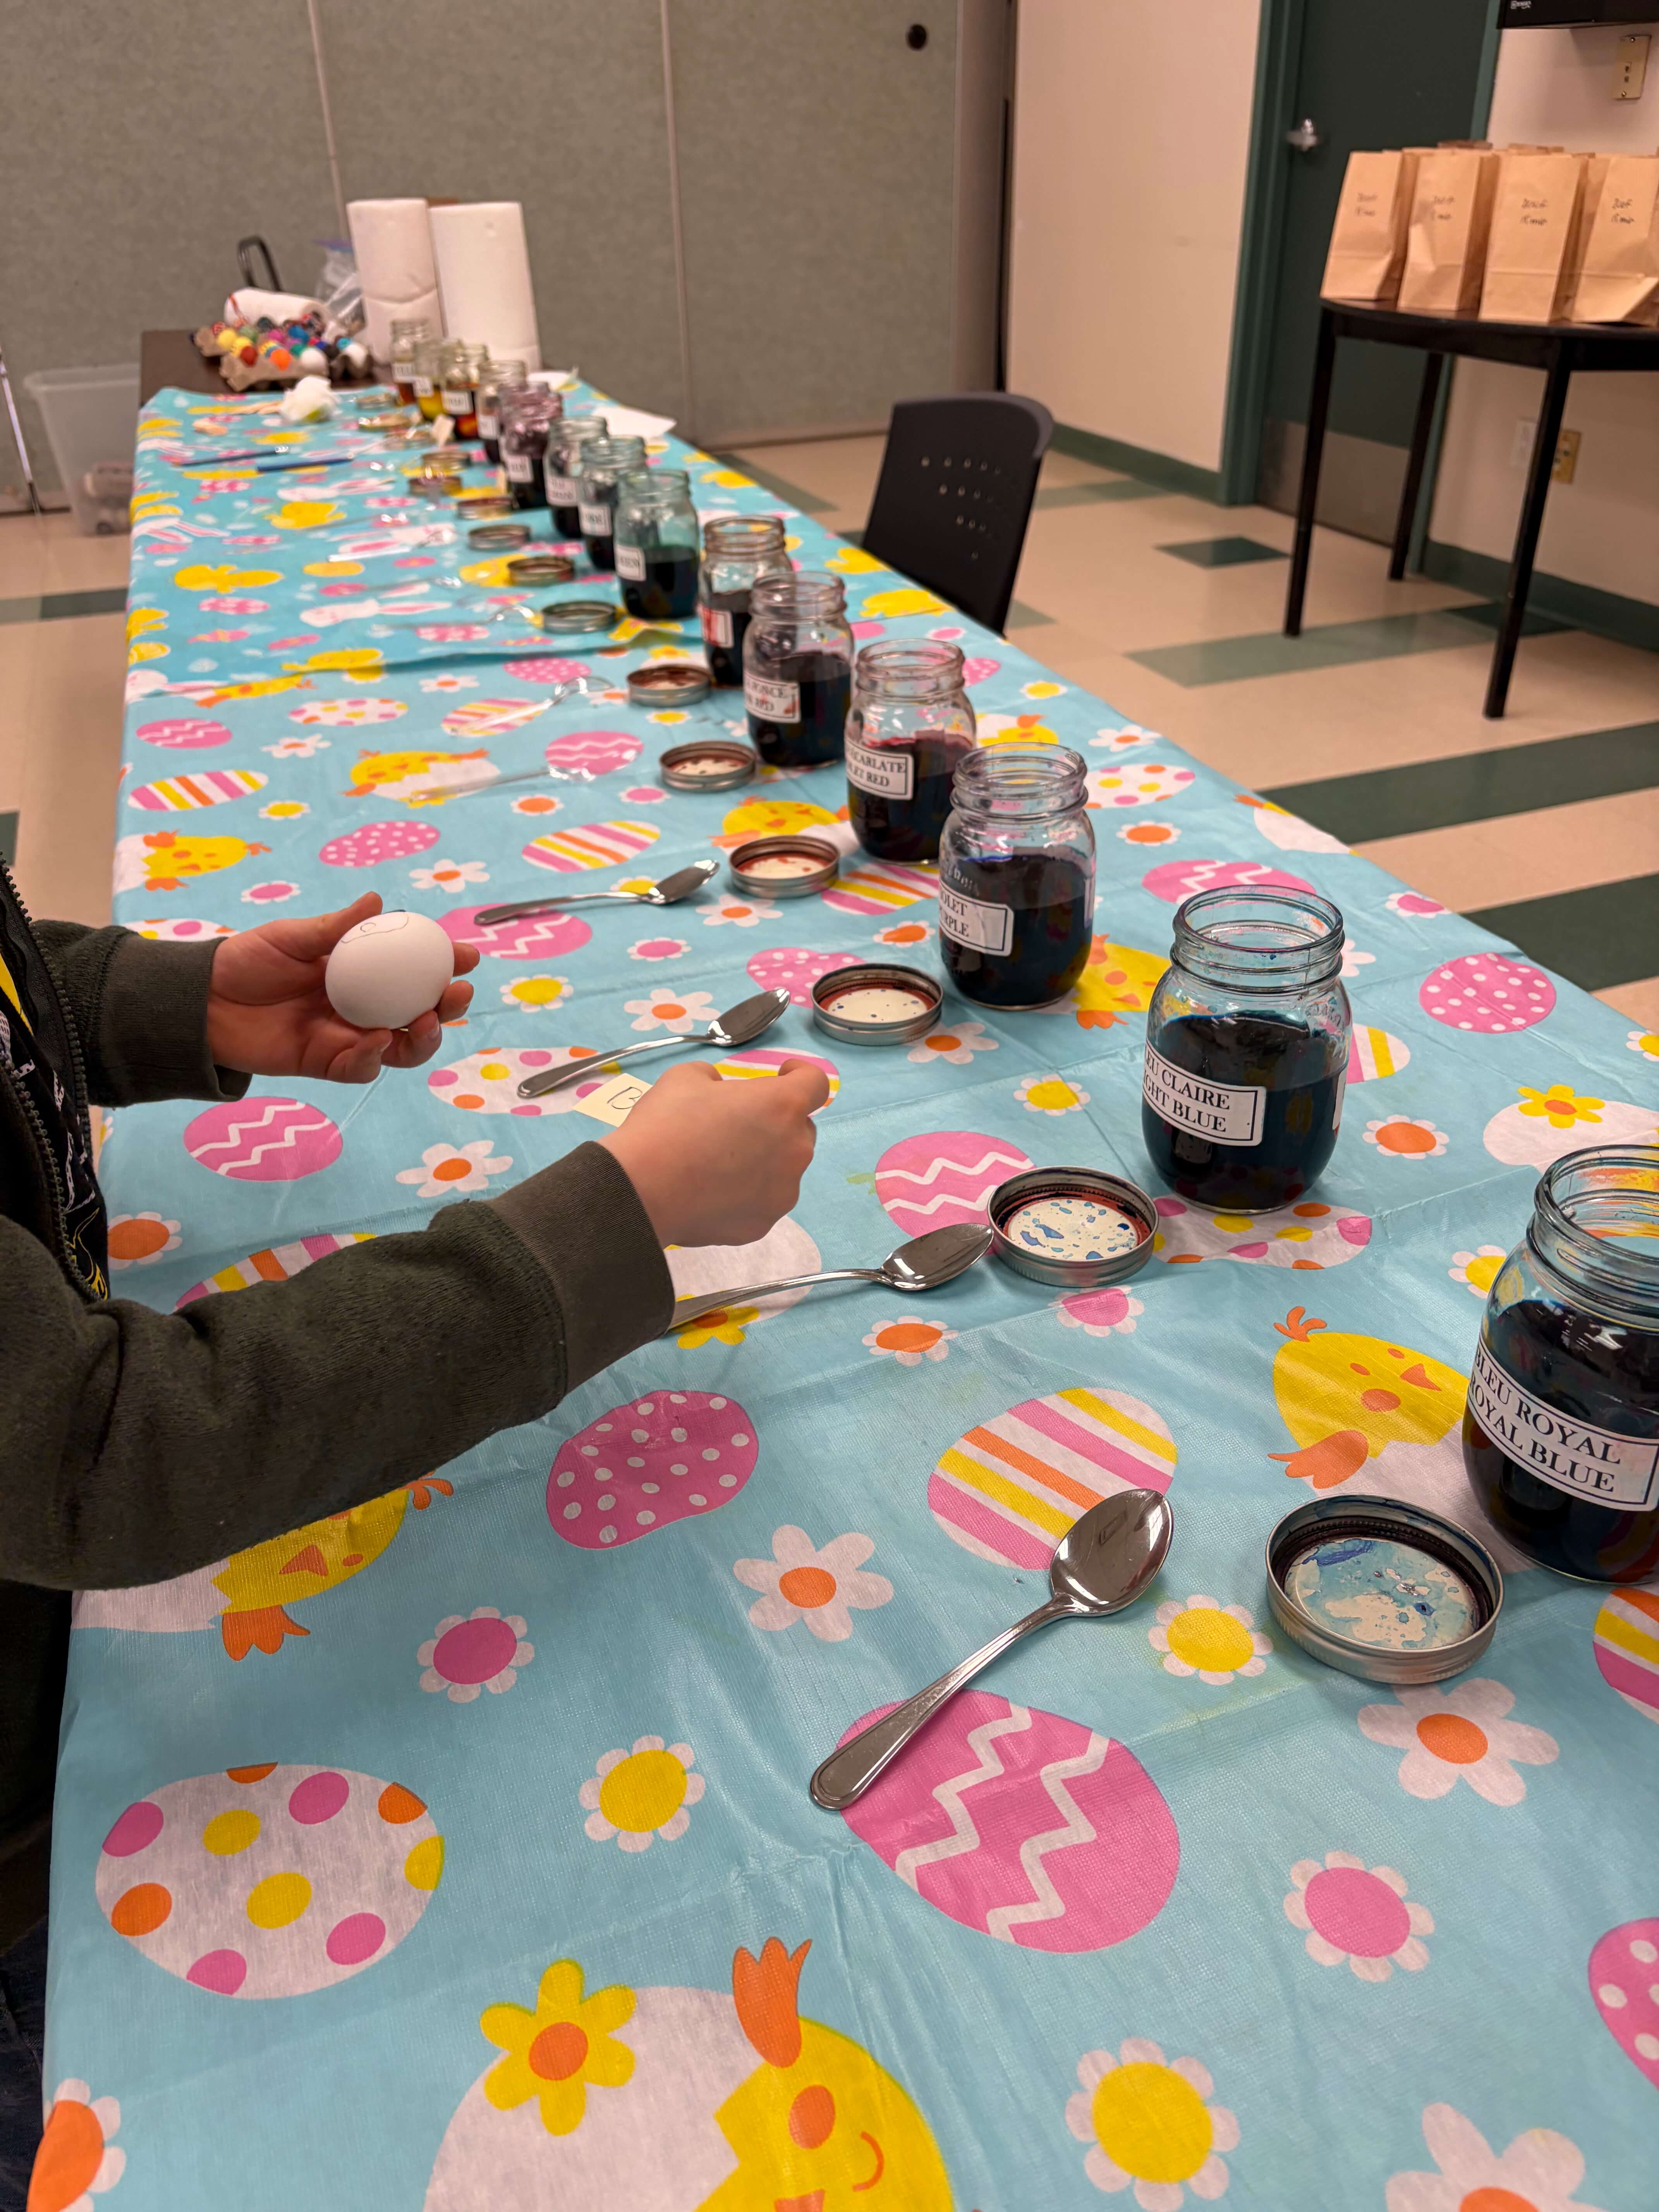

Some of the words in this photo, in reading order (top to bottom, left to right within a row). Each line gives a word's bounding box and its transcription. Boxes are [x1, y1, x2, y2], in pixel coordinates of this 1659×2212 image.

[867, 772, 890, 787] RED
[941, 891, 968, 917] OLET
[1143, 1070, 1169, 1107] IGHT
[1172, 1098, 1226, 1132] BLUE
[1161, 1069, 1230, 1110] CLAIRE
[1470, 1370, 1524, 1451] ROYAL
[1528, 1438, 1614, 1492] BLUE
[1475, 1347, 1512, 1405] BLEU
[1515, 1397, 1621, 1464] ROYAL
